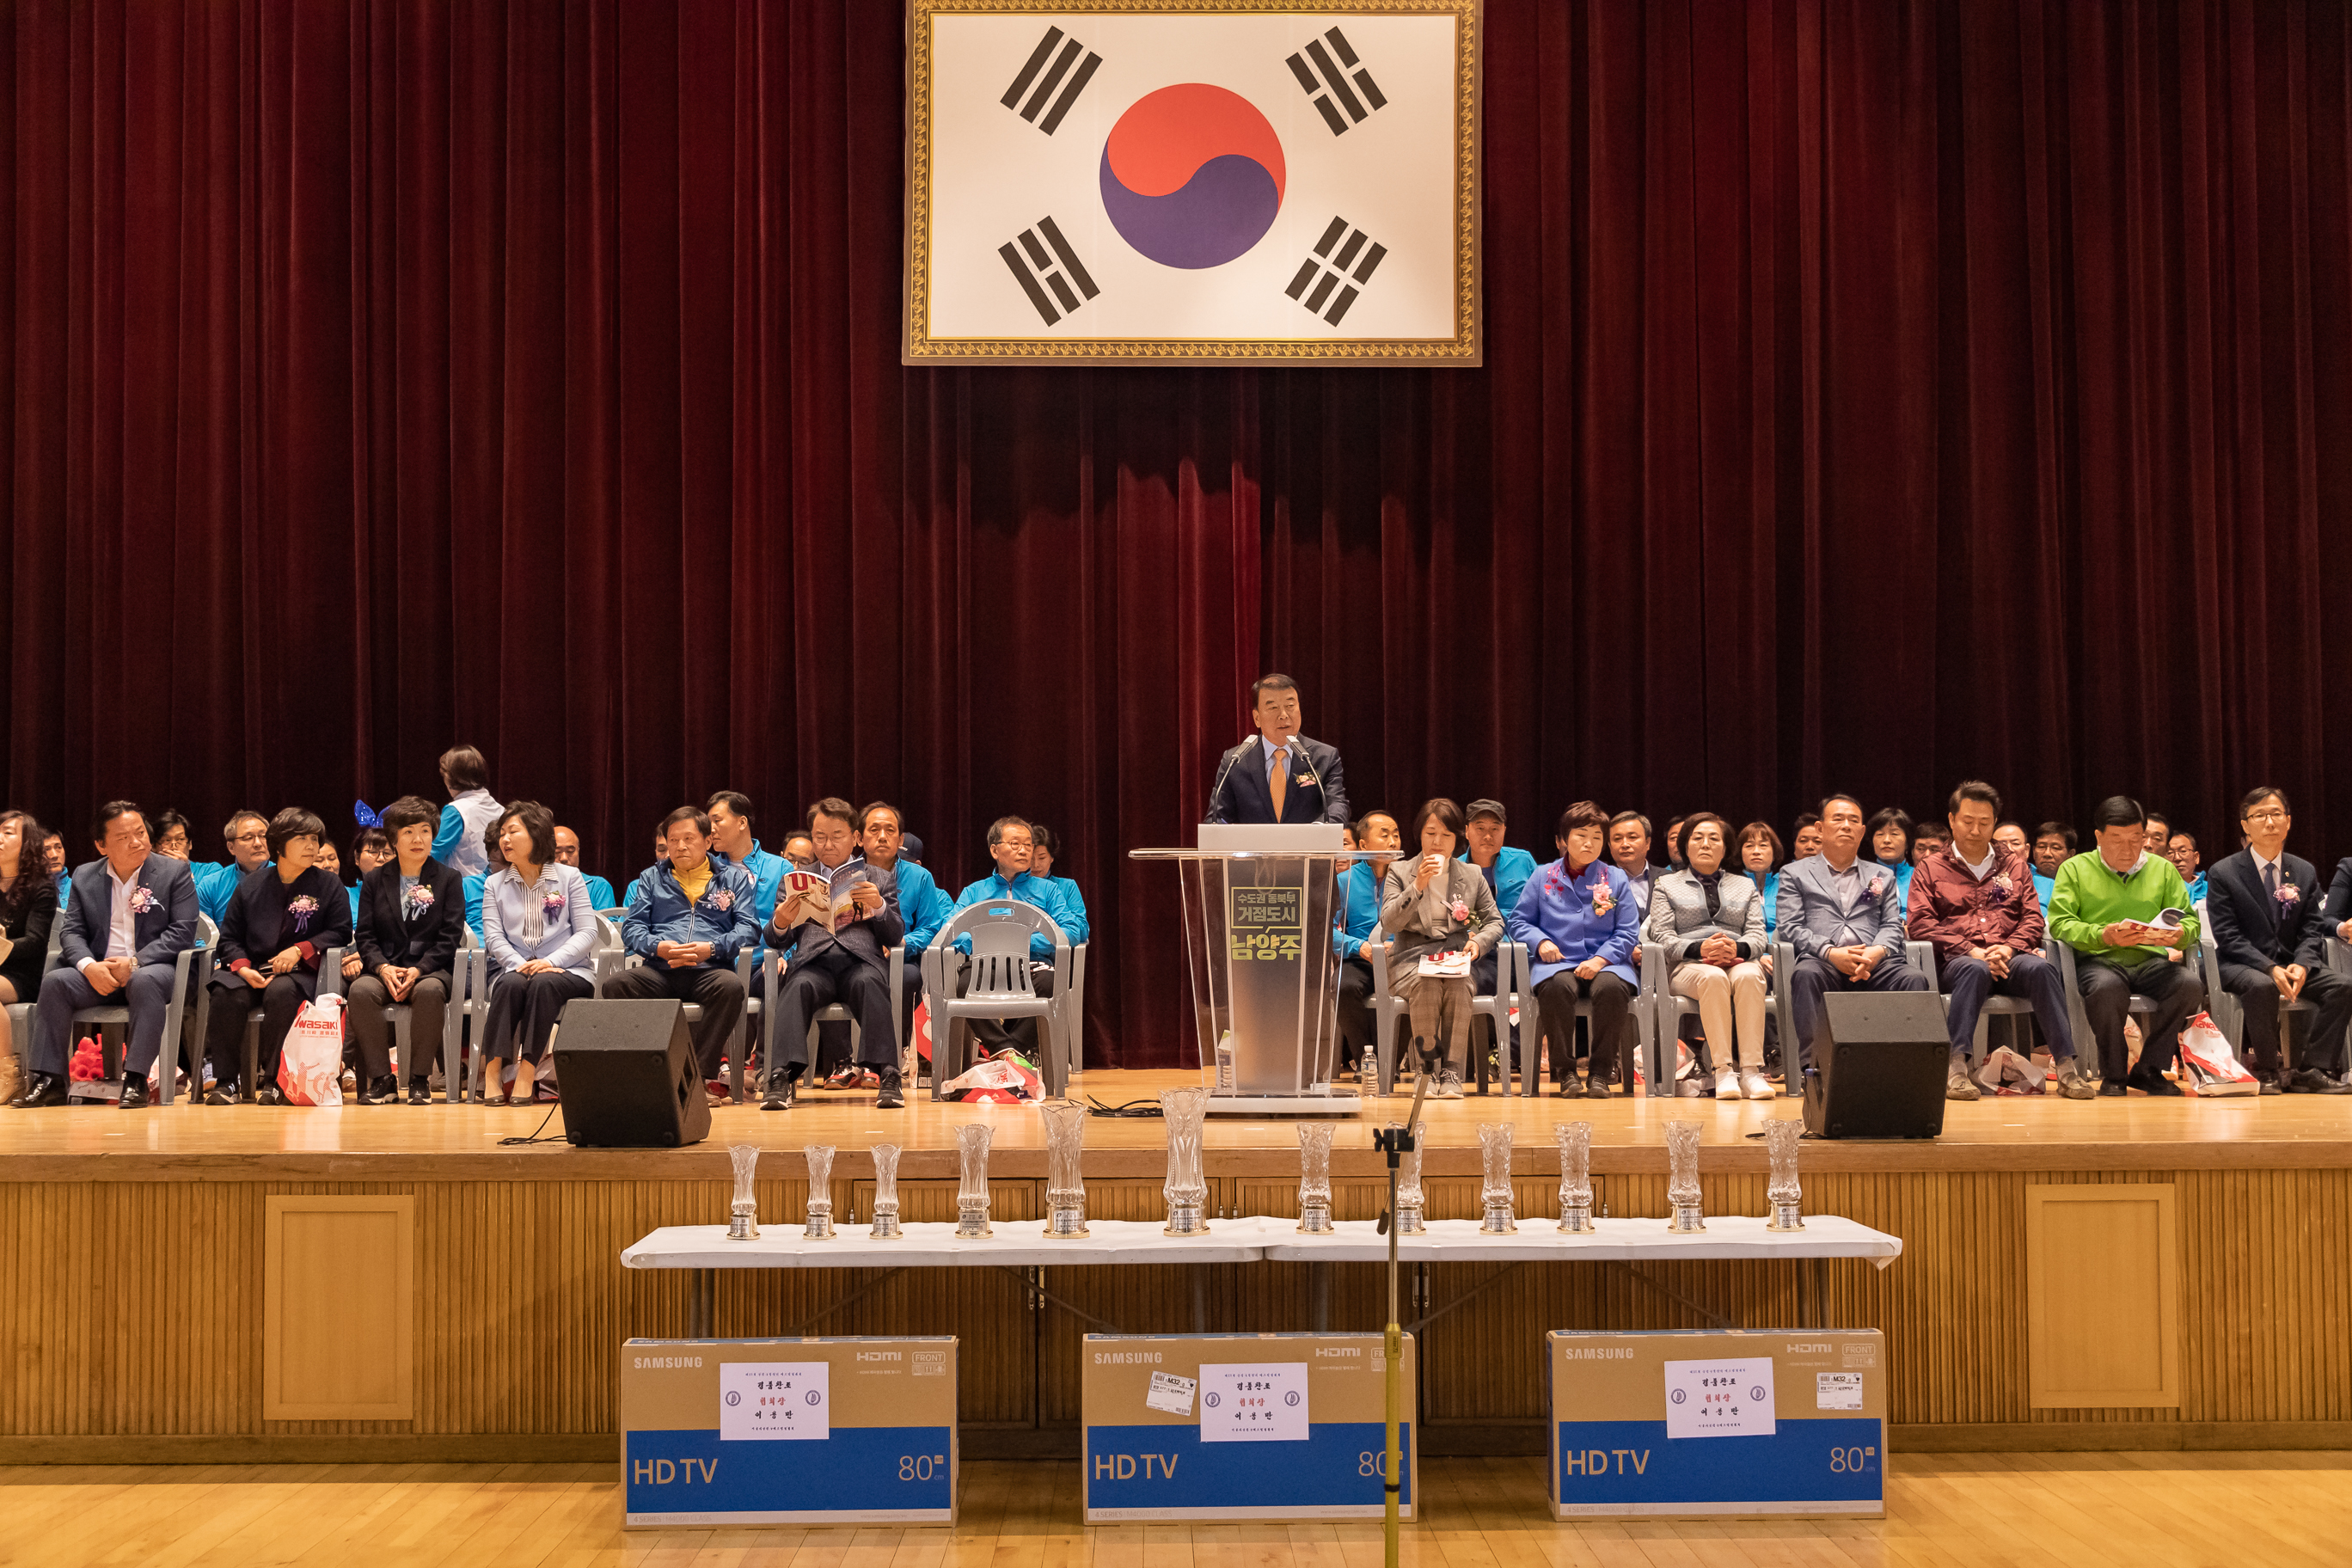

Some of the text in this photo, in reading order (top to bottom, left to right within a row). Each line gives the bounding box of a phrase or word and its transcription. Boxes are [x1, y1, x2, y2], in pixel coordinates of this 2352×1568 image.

[1237, 893, 1295, 903] 수도권 동북부
[1238, 906, 1295, 922] 거점도시
[1231, 934, 1302, 961] 남양주
[1315, 1347, 1361, 1357] HDMI
[1786, 1343, 1832, 1353] HDMI
[1845, 1345, 1872, 1354] FRONT
[856, 1351, 902, 1361] HDMI
[1094, 1351, 1162, 1364] SAMSUNG
[1565, 1347, 1634, 1360] SAMSUNG
[634, 1357, 702, 1369] SAMSUNG
[1167, 1377, 1181, 1386] M32
[760, 1397, 786, 1406] 협회장
[1240, 1398, 1265, 1407] 협회장
[1706, 1393, 1731, 1403] 협회장
[1358, 1450, 1386, 1477] 80
[1830, 1447, 1864, 1473] 80
[898, 1455, 933, 1481] 80
